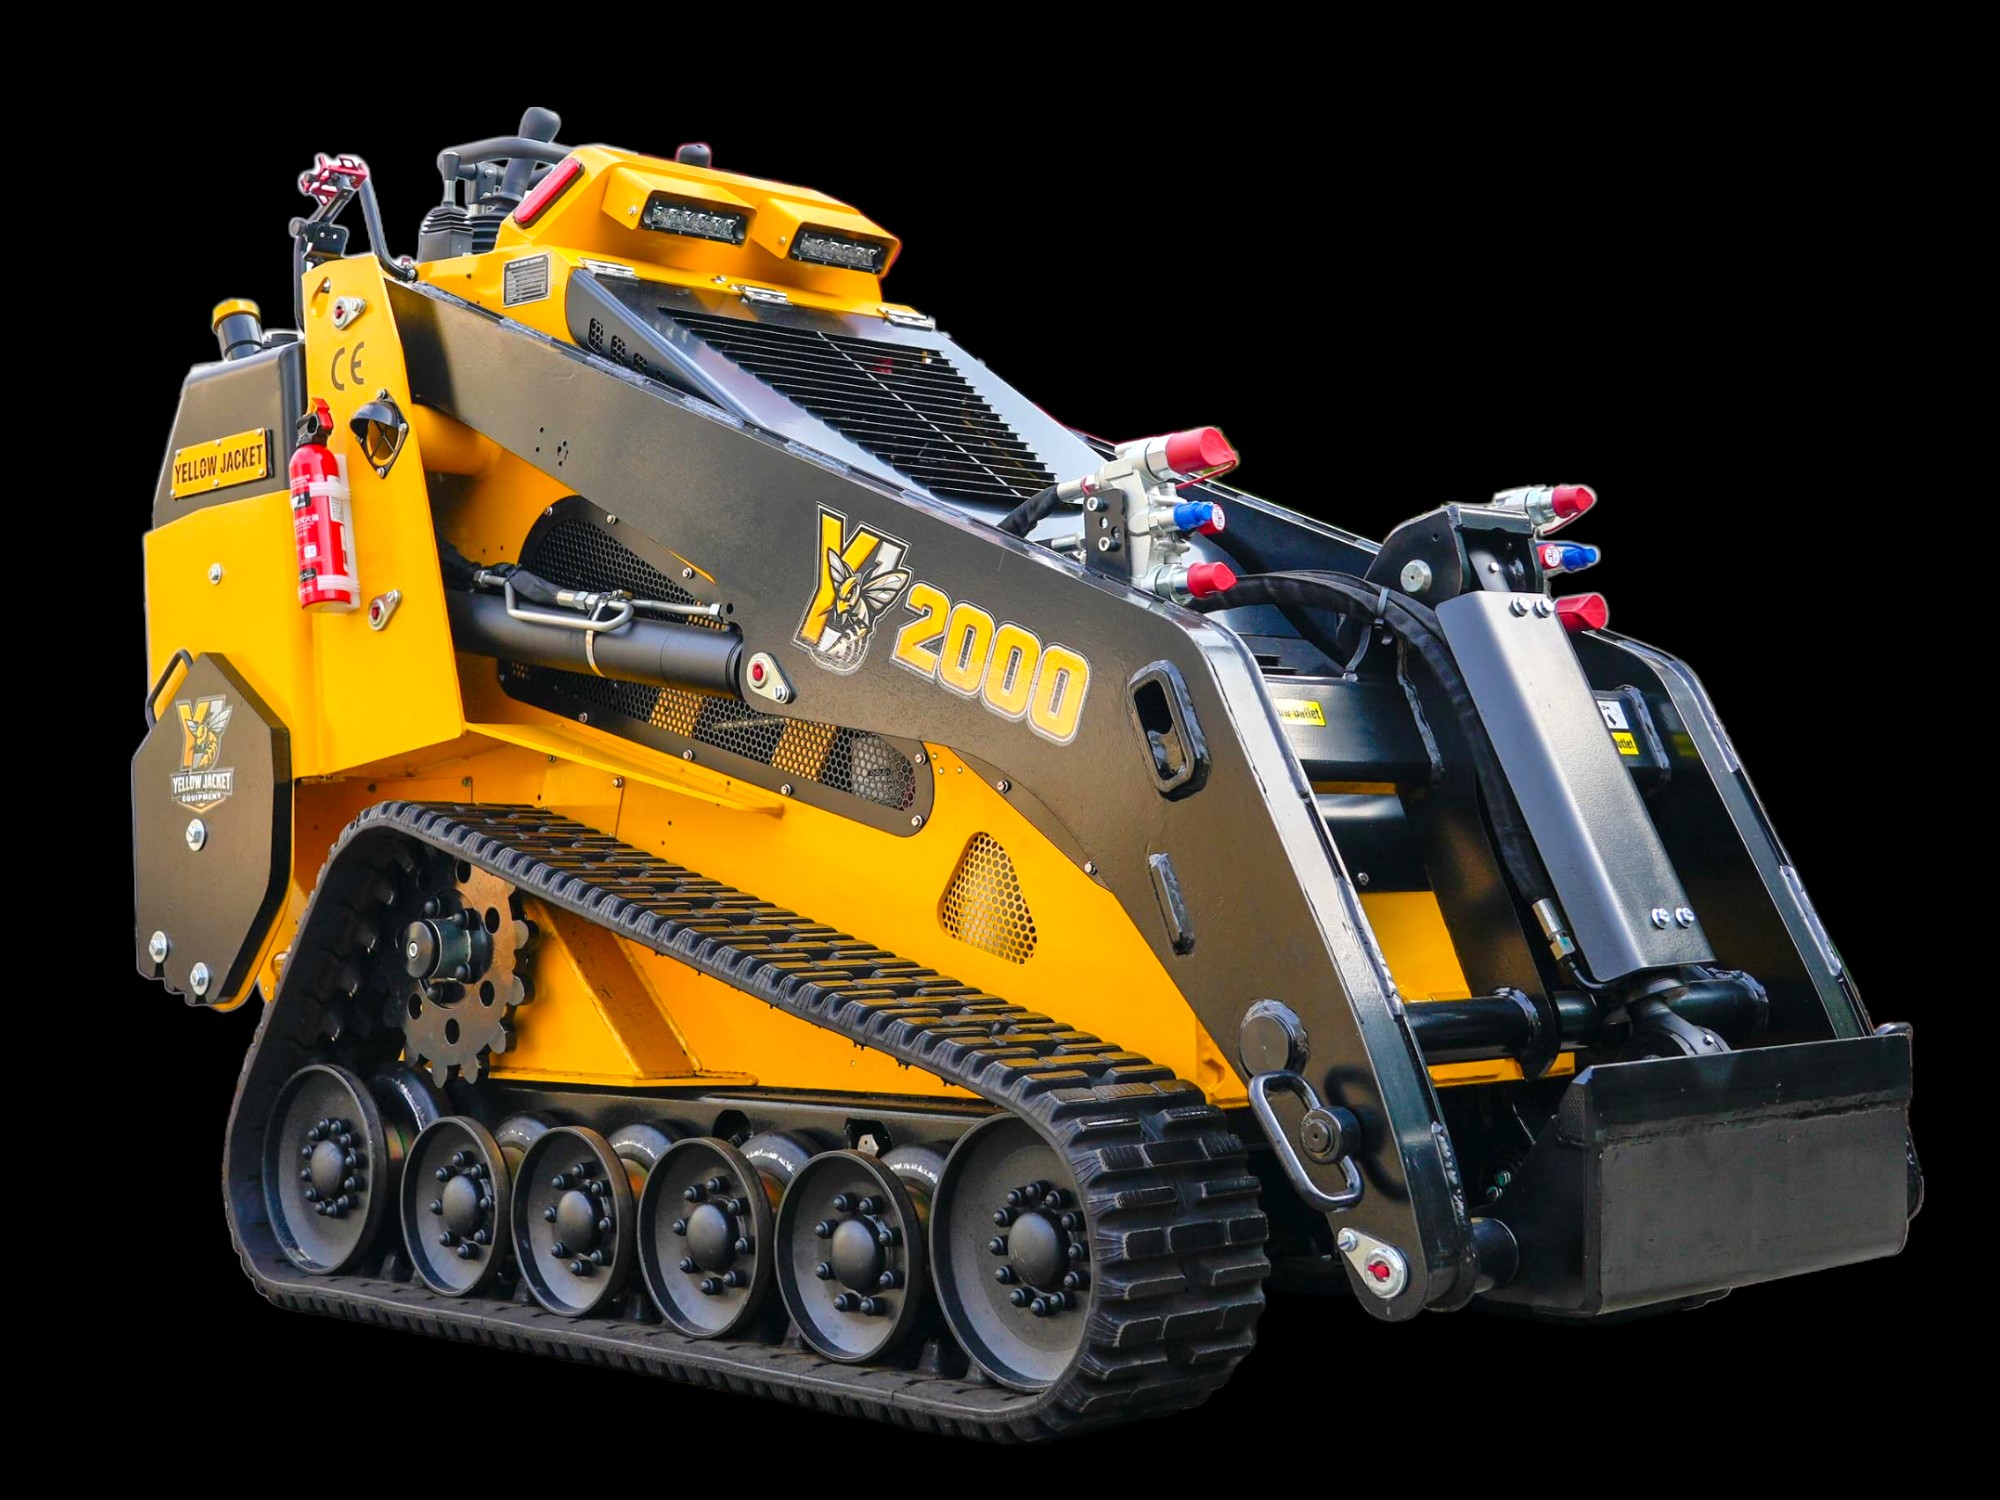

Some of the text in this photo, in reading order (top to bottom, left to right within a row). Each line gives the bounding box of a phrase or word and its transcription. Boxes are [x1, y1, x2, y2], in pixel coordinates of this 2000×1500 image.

[331, 341, 365, 391] CE
[174, 444, 263, 485] YELLOW JACKET
[892, 581, 1091, 744] 2000
[172, 772, 231, 795] YELLOW JACKET
[182, 793, 222, 803] EQUIPMENT
